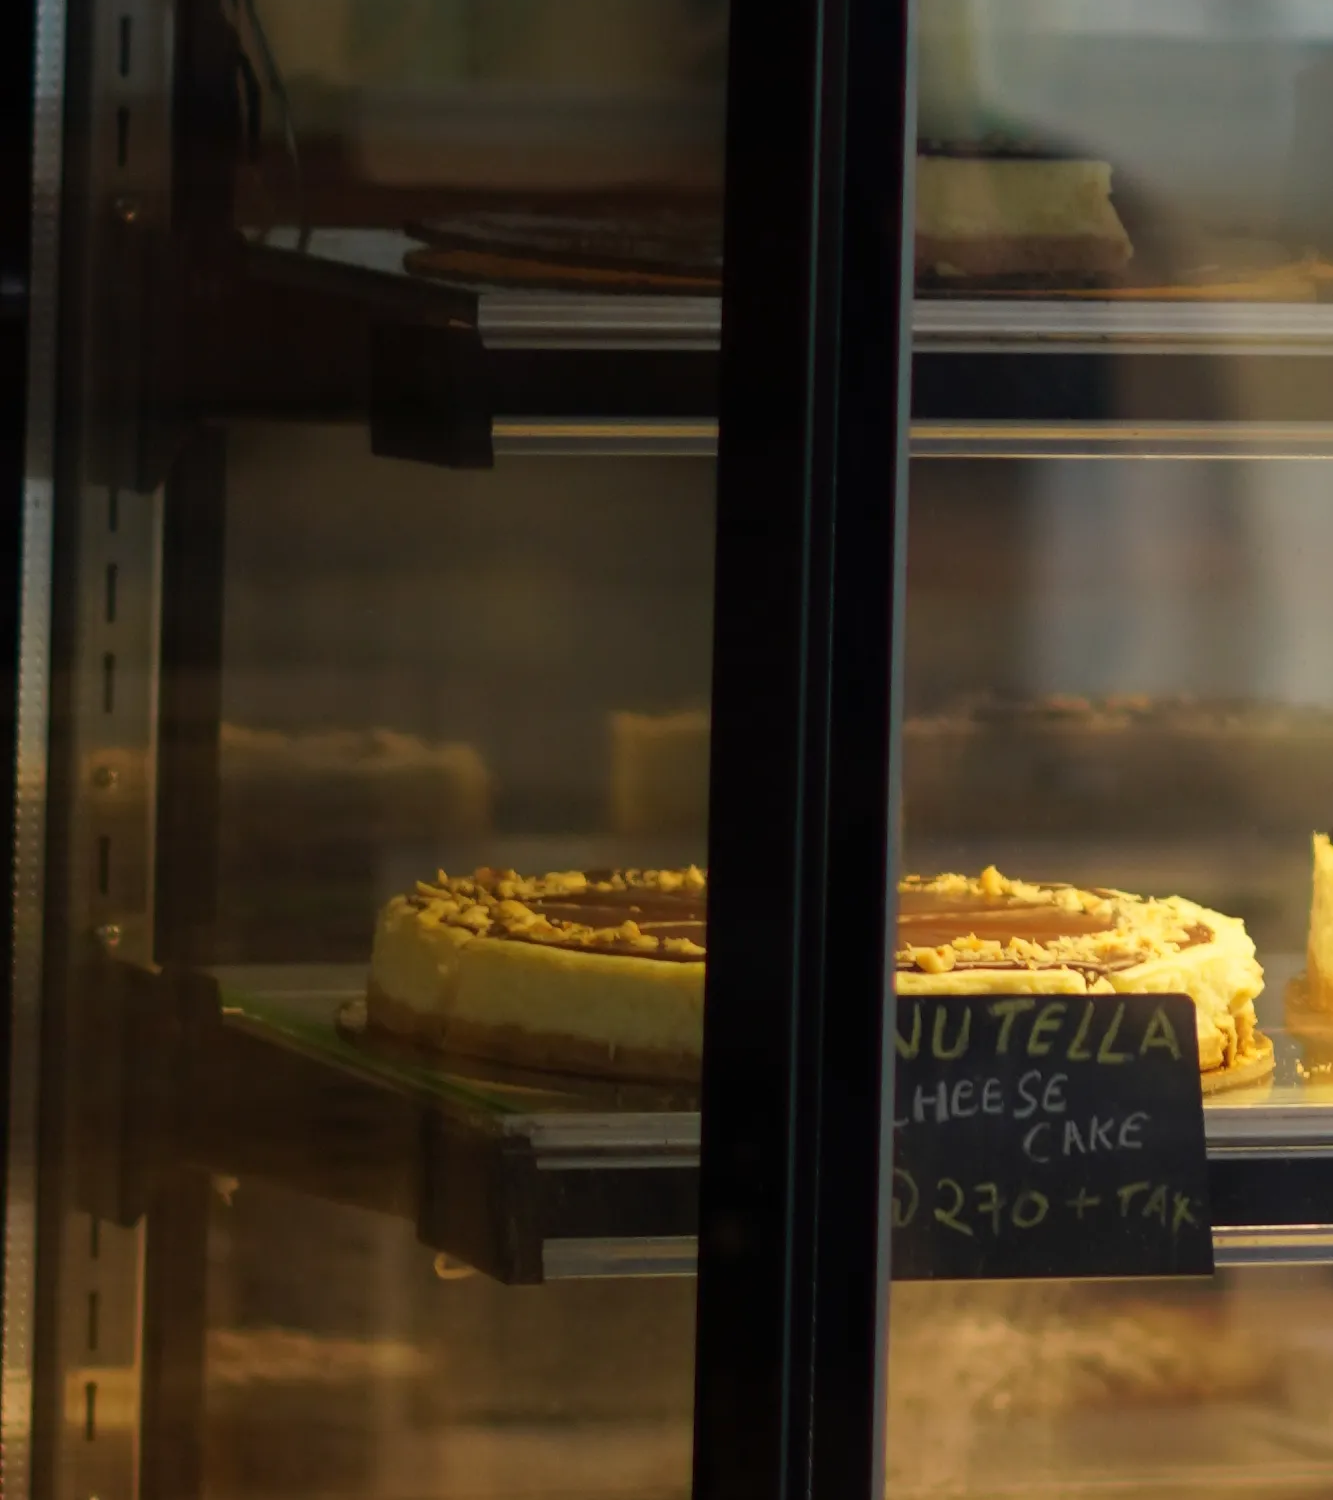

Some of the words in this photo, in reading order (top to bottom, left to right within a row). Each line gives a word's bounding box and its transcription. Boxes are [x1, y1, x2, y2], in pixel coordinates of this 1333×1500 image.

[893, 1069, 1069, 1128] HEESE
[1023, 1112, 1152, 1163] CAKE
[1117, 1181, 1200, 1234] TAX
